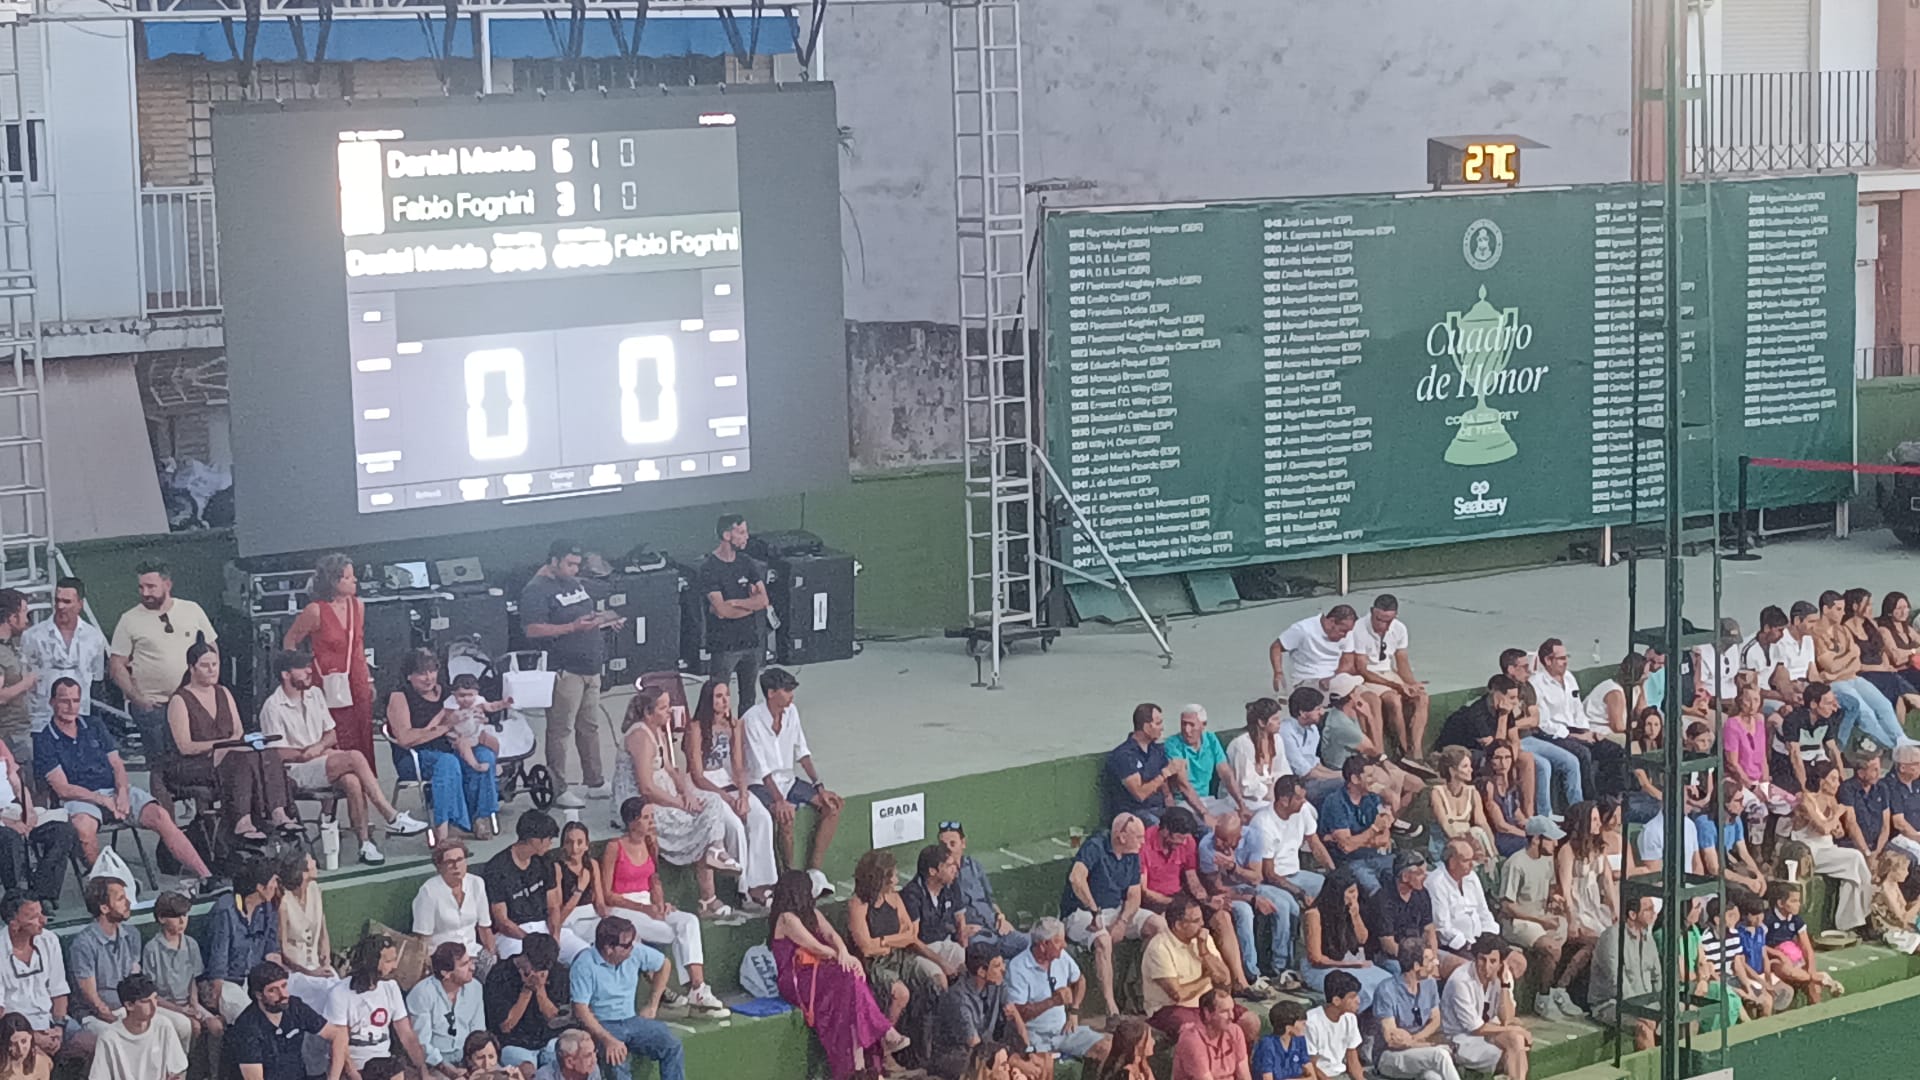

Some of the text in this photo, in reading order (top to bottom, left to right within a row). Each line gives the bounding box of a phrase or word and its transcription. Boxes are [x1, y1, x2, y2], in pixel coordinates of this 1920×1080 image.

[387, 148, 457, 178] Daniel
[591, 140, 600, 168] 1
[620, 138, 635, 167] 0
[393, 181, 637, 221] Fabio Fognini 3 1 0
[615, 232, 667, 258] Fabio
[671, 227, 739, 256] Fognini
[1426, 314, 1532, 356] Cuadro
[617, 334, 679, 444] 0
[1416, 364, 1549, 401] de Honor
[464, 348, 528, 461] 0
[880, 802, 918, 818] GRADA
